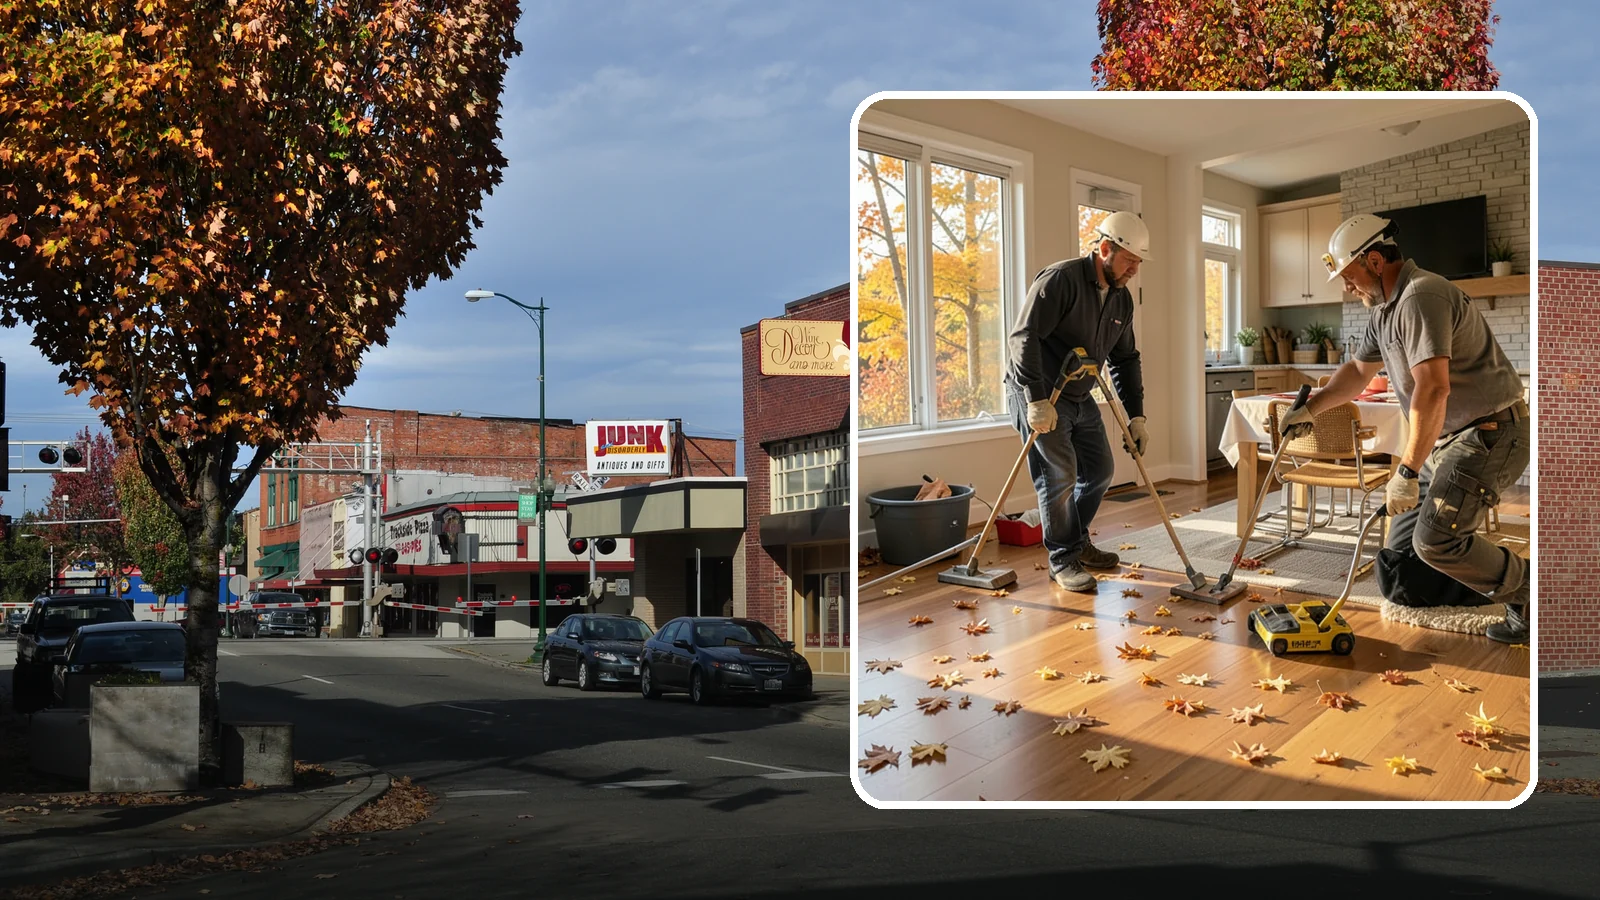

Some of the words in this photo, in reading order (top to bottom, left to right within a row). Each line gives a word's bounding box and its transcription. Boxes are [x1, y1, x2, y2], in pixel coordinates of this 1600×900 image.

[595, 425, 664, 457] JUNK
[607, 446, 645, 454] DISORDERLY
[597, 461, 628, 470] ANTIQUES
[631, 461, 644, 470] AND
[647, 460, 665, 469] GIFTS
